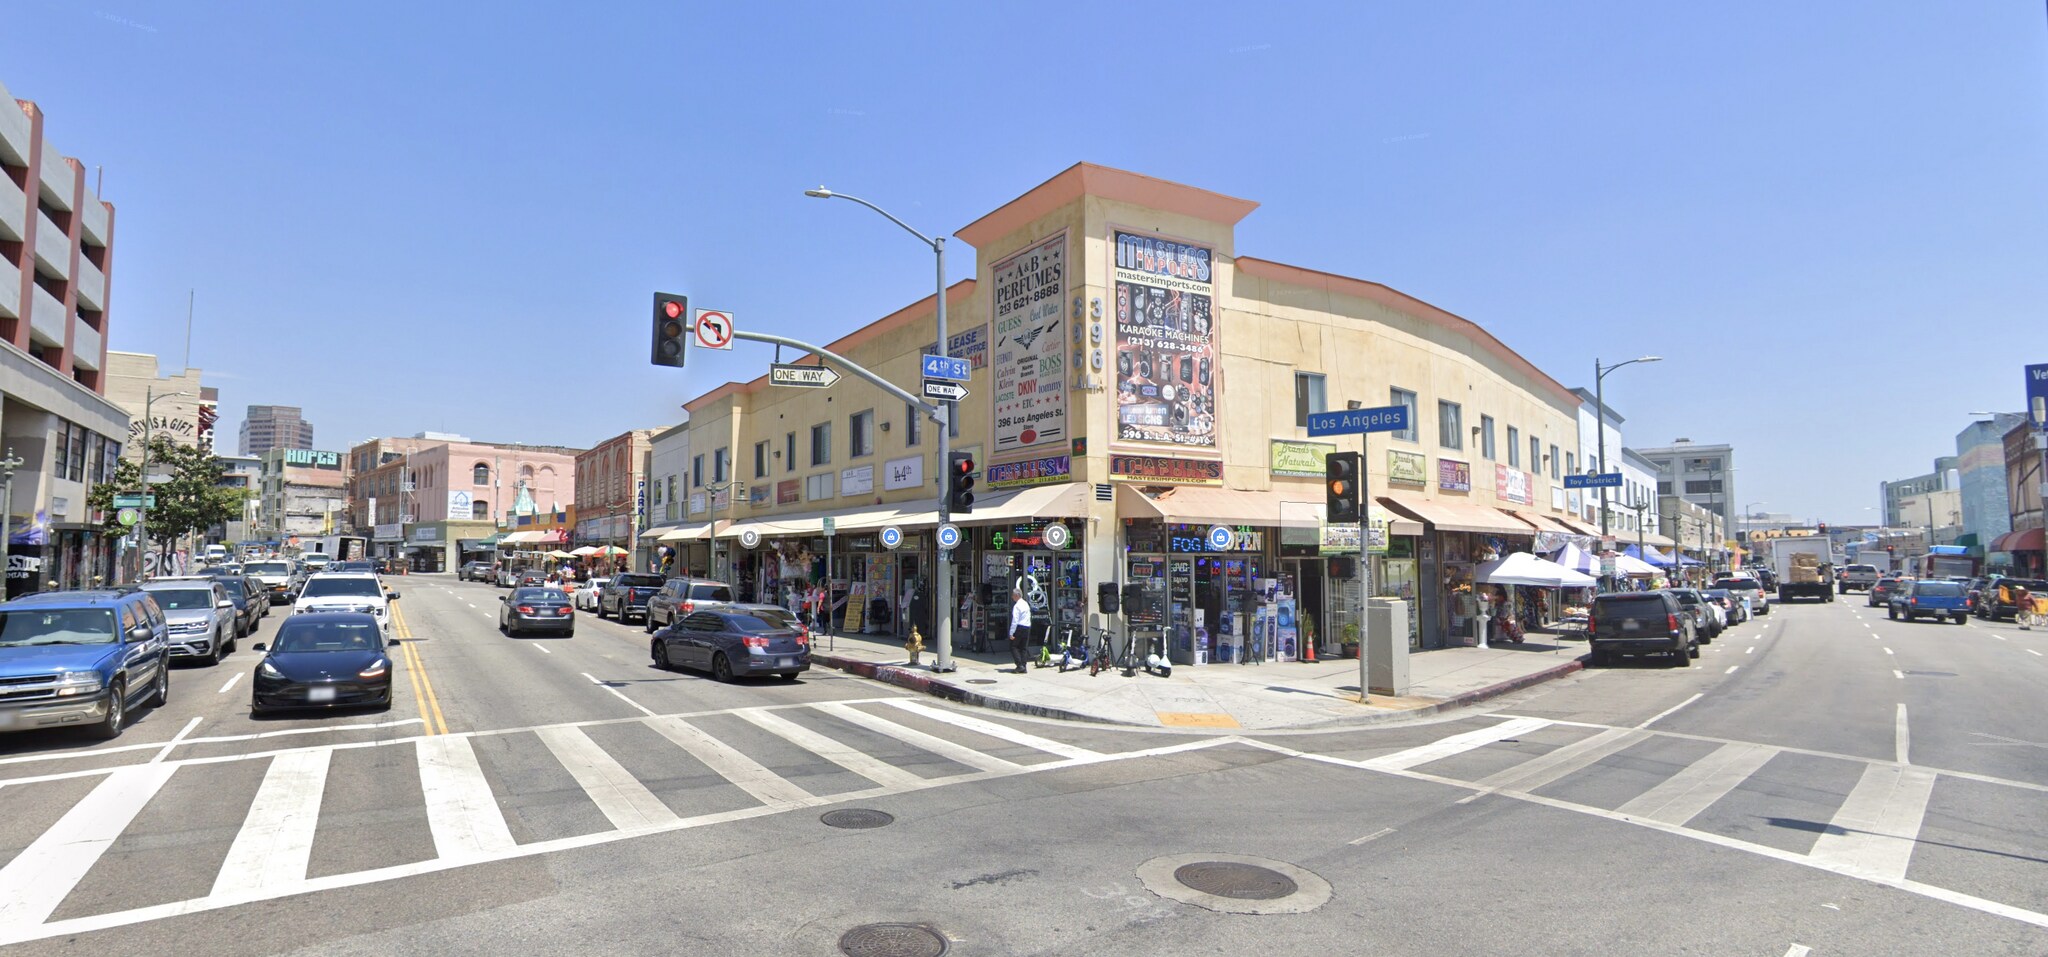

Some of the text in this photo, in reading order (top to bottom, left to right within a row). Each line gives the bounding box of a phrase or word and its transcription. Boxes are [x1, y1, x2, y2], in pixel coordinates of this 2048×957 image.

[997, 262, 1062, 304] PERFUMES
[1117, 270, 1211, 293] mastersimports.com
[999, 302, 1012, 314] 213
[998, 315, 1022, 334] GUESS
[1119, 323, 1210, 344] KARAOKE MACHINES
[948, 331, 977, 351] LEASE
[966, 341, 986, 355] OFFICE
[1126, 335, 1204, 354] (213) 628-3486
[927, 359, 967, 375] 4th St
[1039, 352, 1061, 373] BOSS
[775, 369, 823, 382] ONE WAY
[2033, 369, 2048, 380] Ve
[927, 385, 955, 395] ONE WAY
[1017, 379, 1037, 396] DKNY
[1022, 398, 1035, 410] ETC.
[998, 408, 1064, 428] 396 Los Angeles St.
[1312, 411, 1402, 430] Los Angeles
[161, 416, 168, 429] A
[170, 417, 194, 437] GIFT.
[1122, 430, 1142, 439] 396
[1277, 442, 1309, 456] Brands
[1277, 455, 1316, 468] Naturals
[1127, 474, 1207, 484] MASTERSIMPORTS.COM
[1570, 476, 1617, 486] Toy District
[1172, 537, 1201, 552] FOG
[986, 555, 1014, 567] SMOKE
[988, 565, 1010, 577] SHOP
